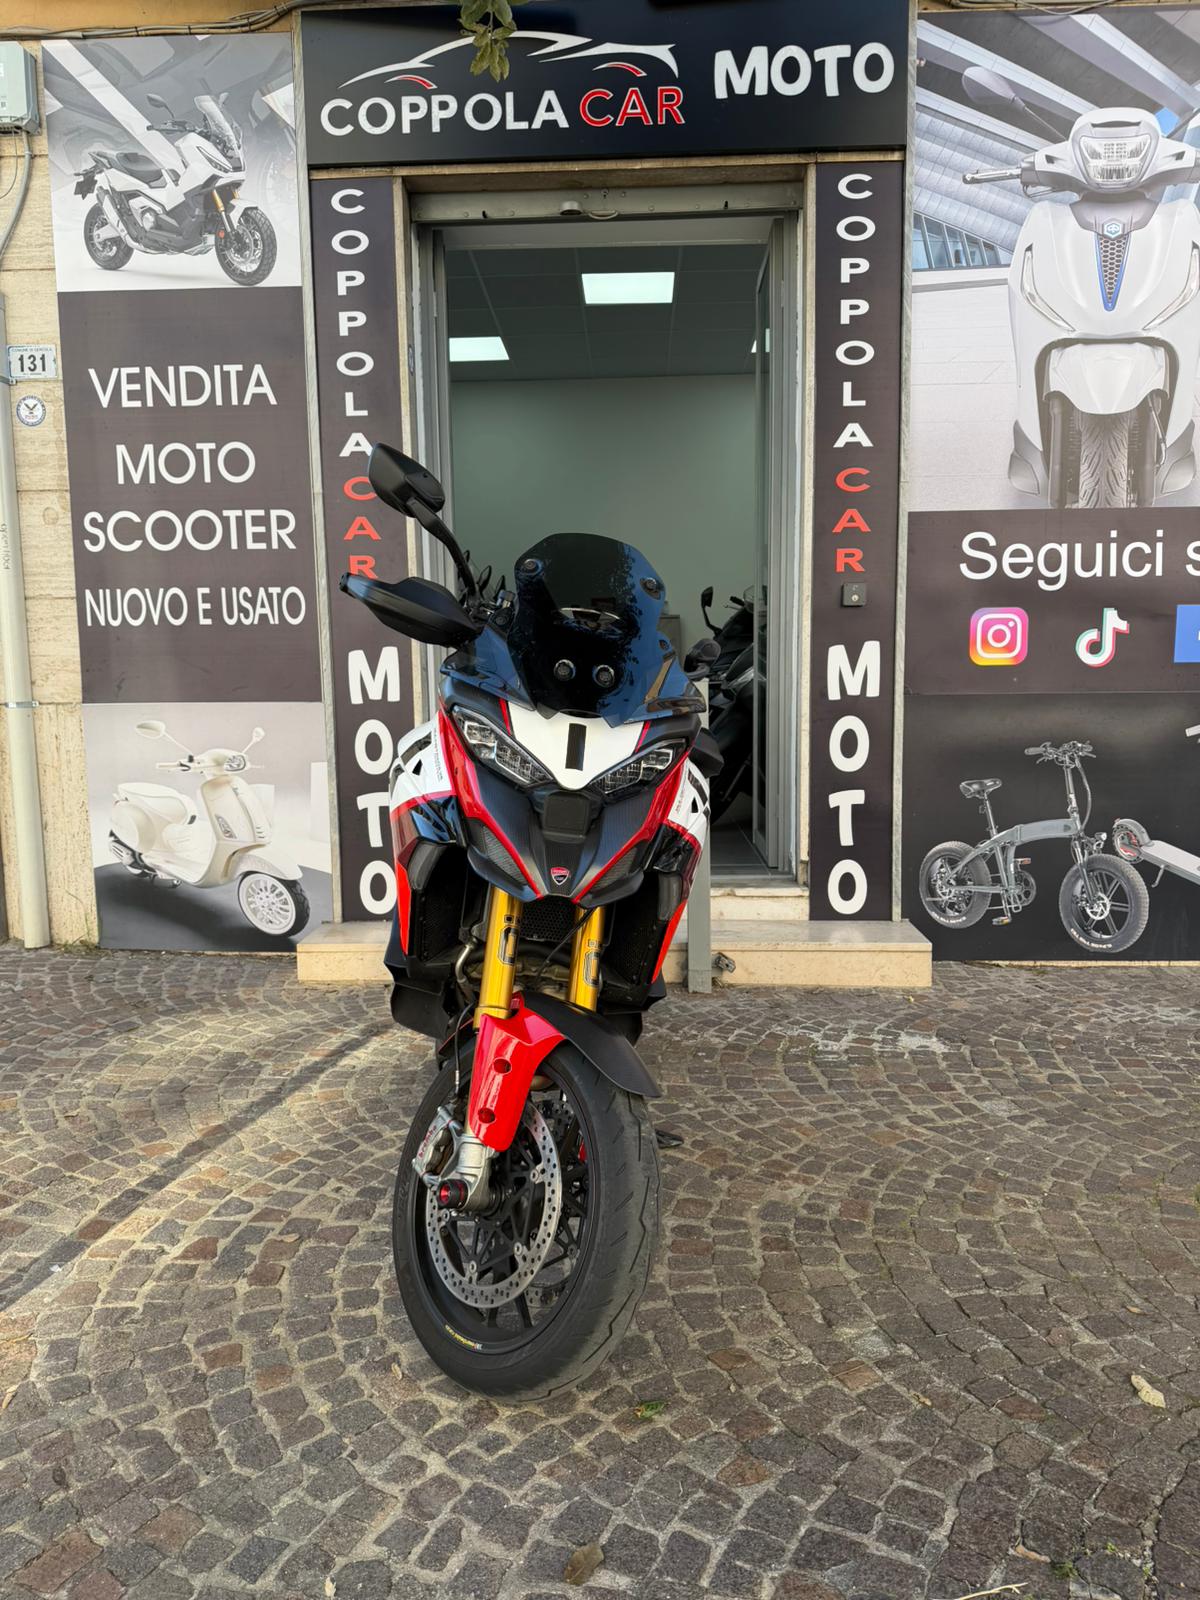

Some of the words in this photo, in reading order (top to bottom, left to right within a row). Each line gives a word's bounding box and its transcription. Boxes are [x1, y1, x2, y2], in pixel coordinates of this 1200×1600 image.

[320, 90, 569, 136] COPPOLA
[580, 86, 685, 127] CAR
[714, 42, 895, 99] MOTO
[331, 188, 375, 457] COPPOLA
[833, 173, 876, 448] COPPOLA
[18, 353, 46, 372] 131
[88, 363, 278, 409] VENDITA
[115, 441, 256, 485] MOTO
[83, 509, 297, 553] SCOOTER
[343, 476, 382, 580] CAR
[832, 467, 871, 573] CAR
[959, 529, 1164, 592] Seguici
[85, 586, 188, 627] NUOVO
[196, 587, 213, 625] E
[221, 586, 306, 626] USATO
[348, 646, 400, 915] MOTO
[827, 640, 881, 915] MOTO
